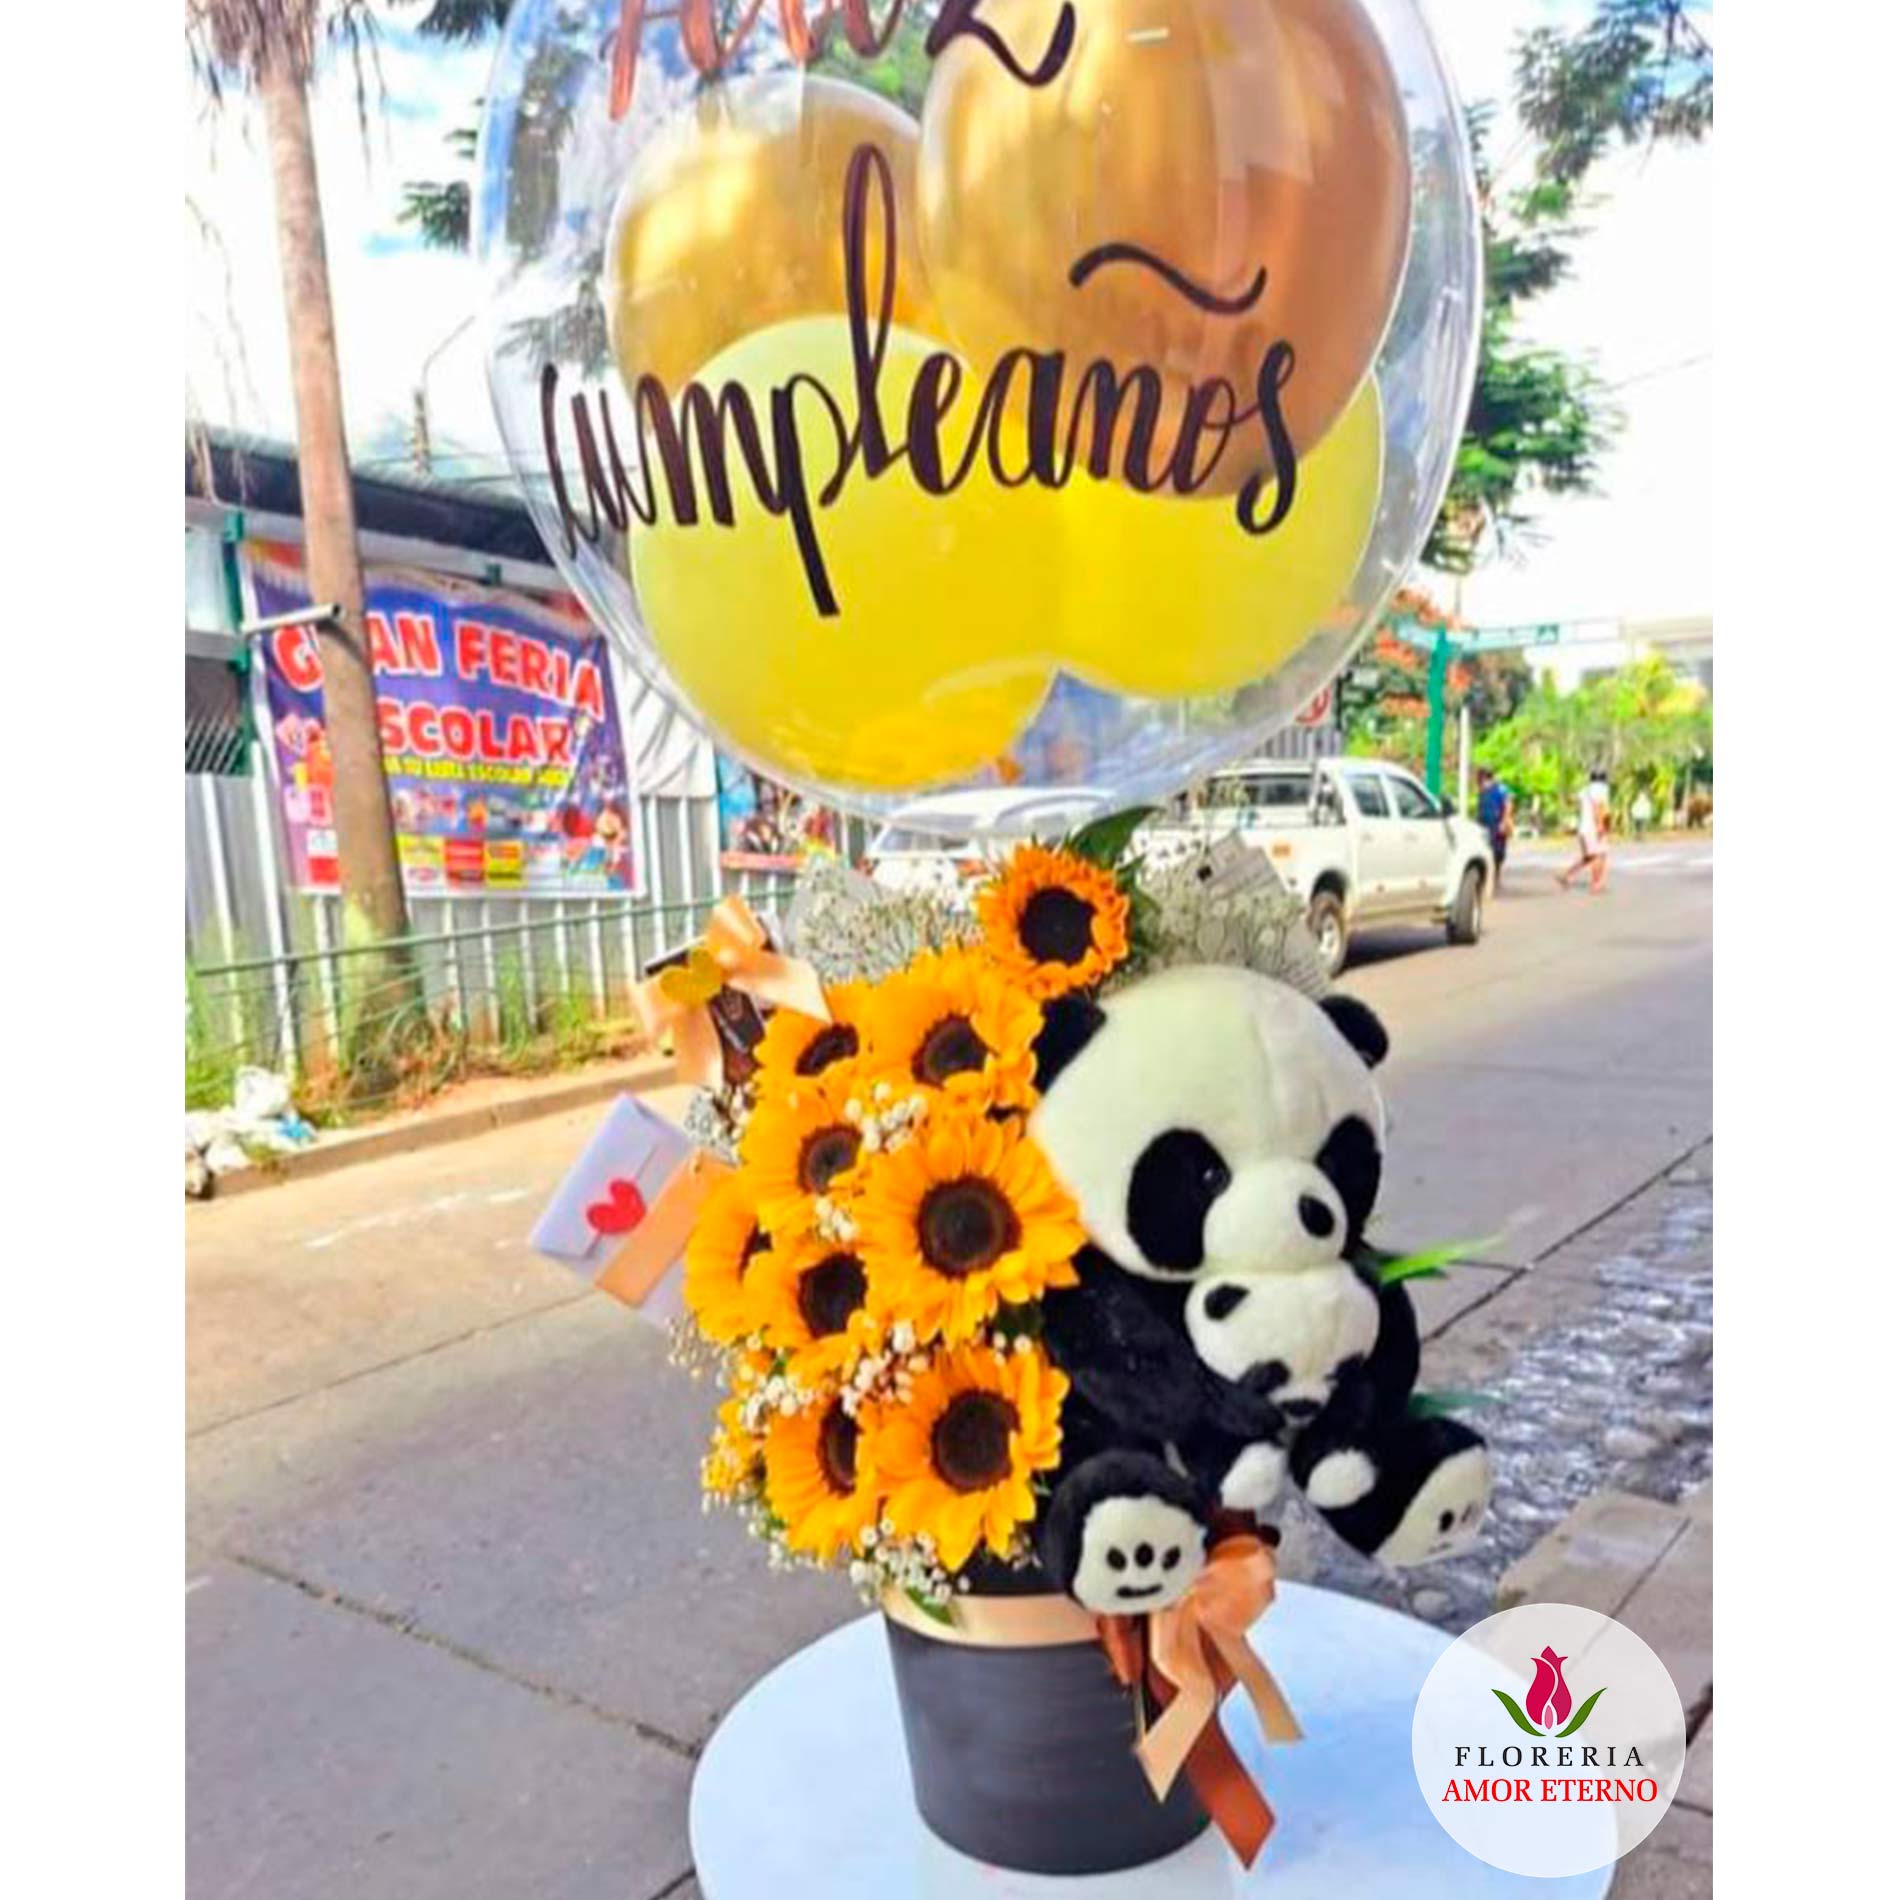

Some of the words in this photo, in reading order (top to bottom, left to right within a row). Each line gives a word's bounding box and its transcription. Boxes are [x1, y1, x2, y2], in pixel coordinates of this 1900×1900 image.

[274, 611, 443, 691] GAN
[455, 619, 605, 721] FERIA
[376, 697, 573, 766] SCOLAR
